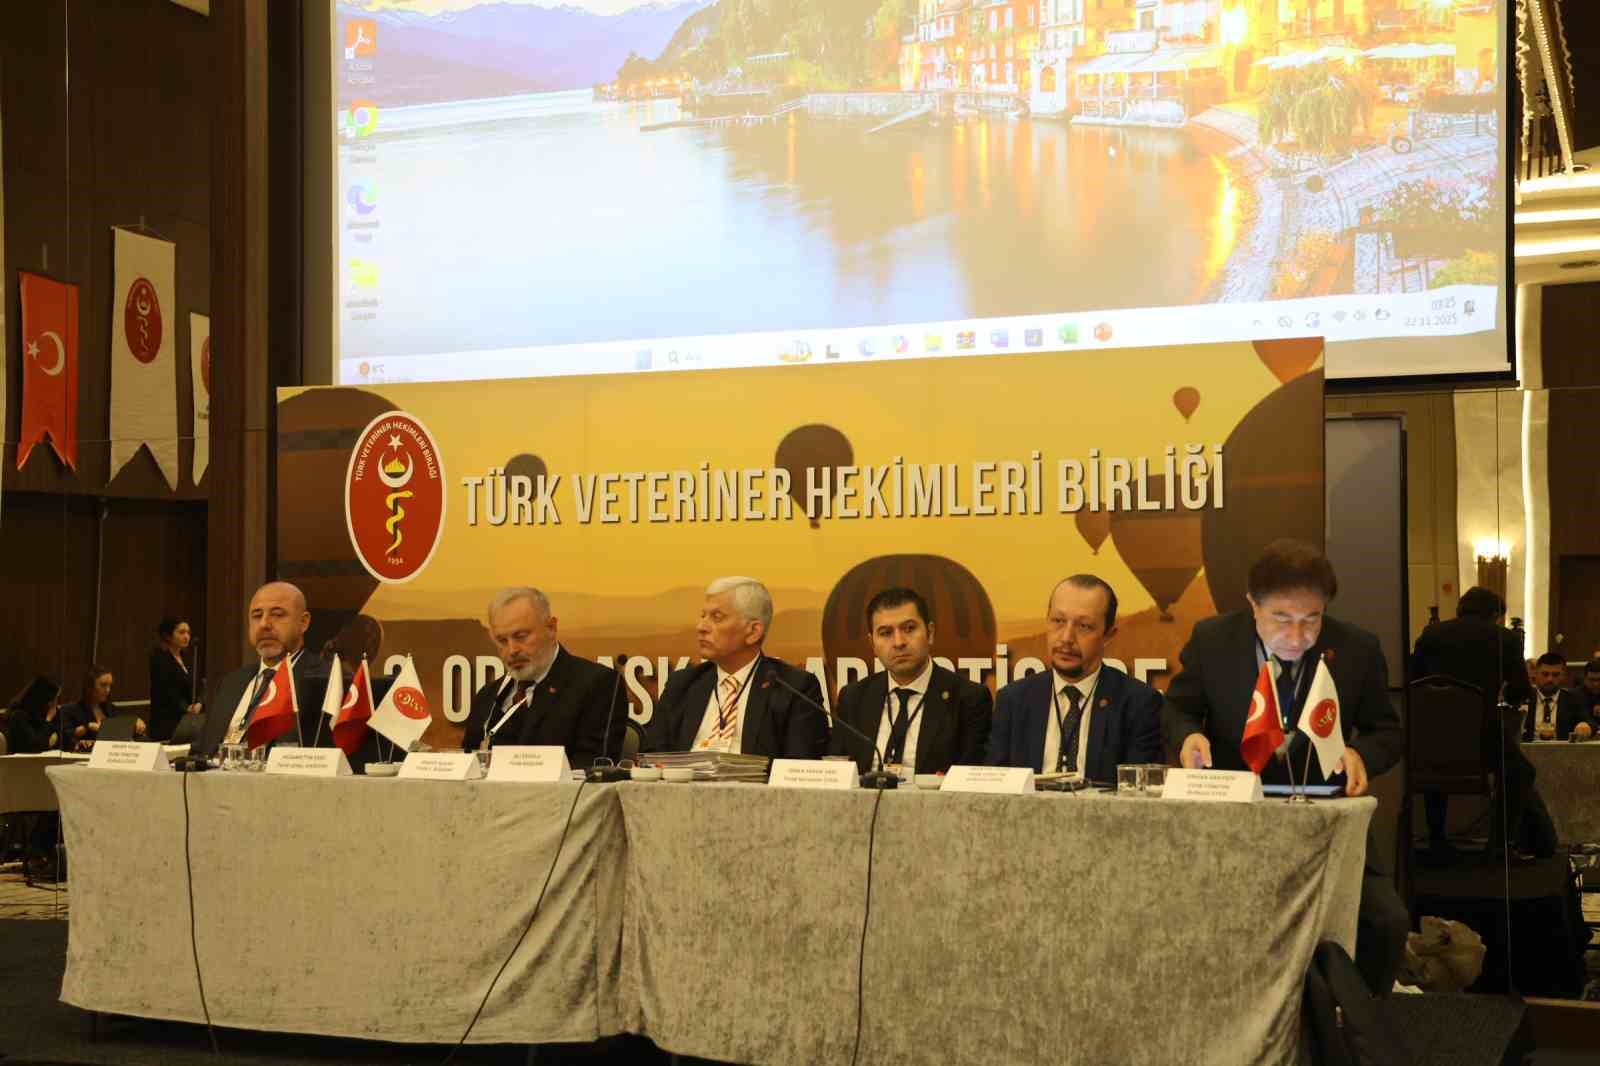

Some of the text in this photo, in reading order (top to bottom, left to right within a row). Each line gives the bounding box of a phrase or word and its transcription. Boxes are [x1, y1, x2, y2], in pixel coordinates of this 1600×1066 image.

[462, 443, 1225, 526] TÜRK VETERİNER HEKİMLERİ BİRLİĞİ
